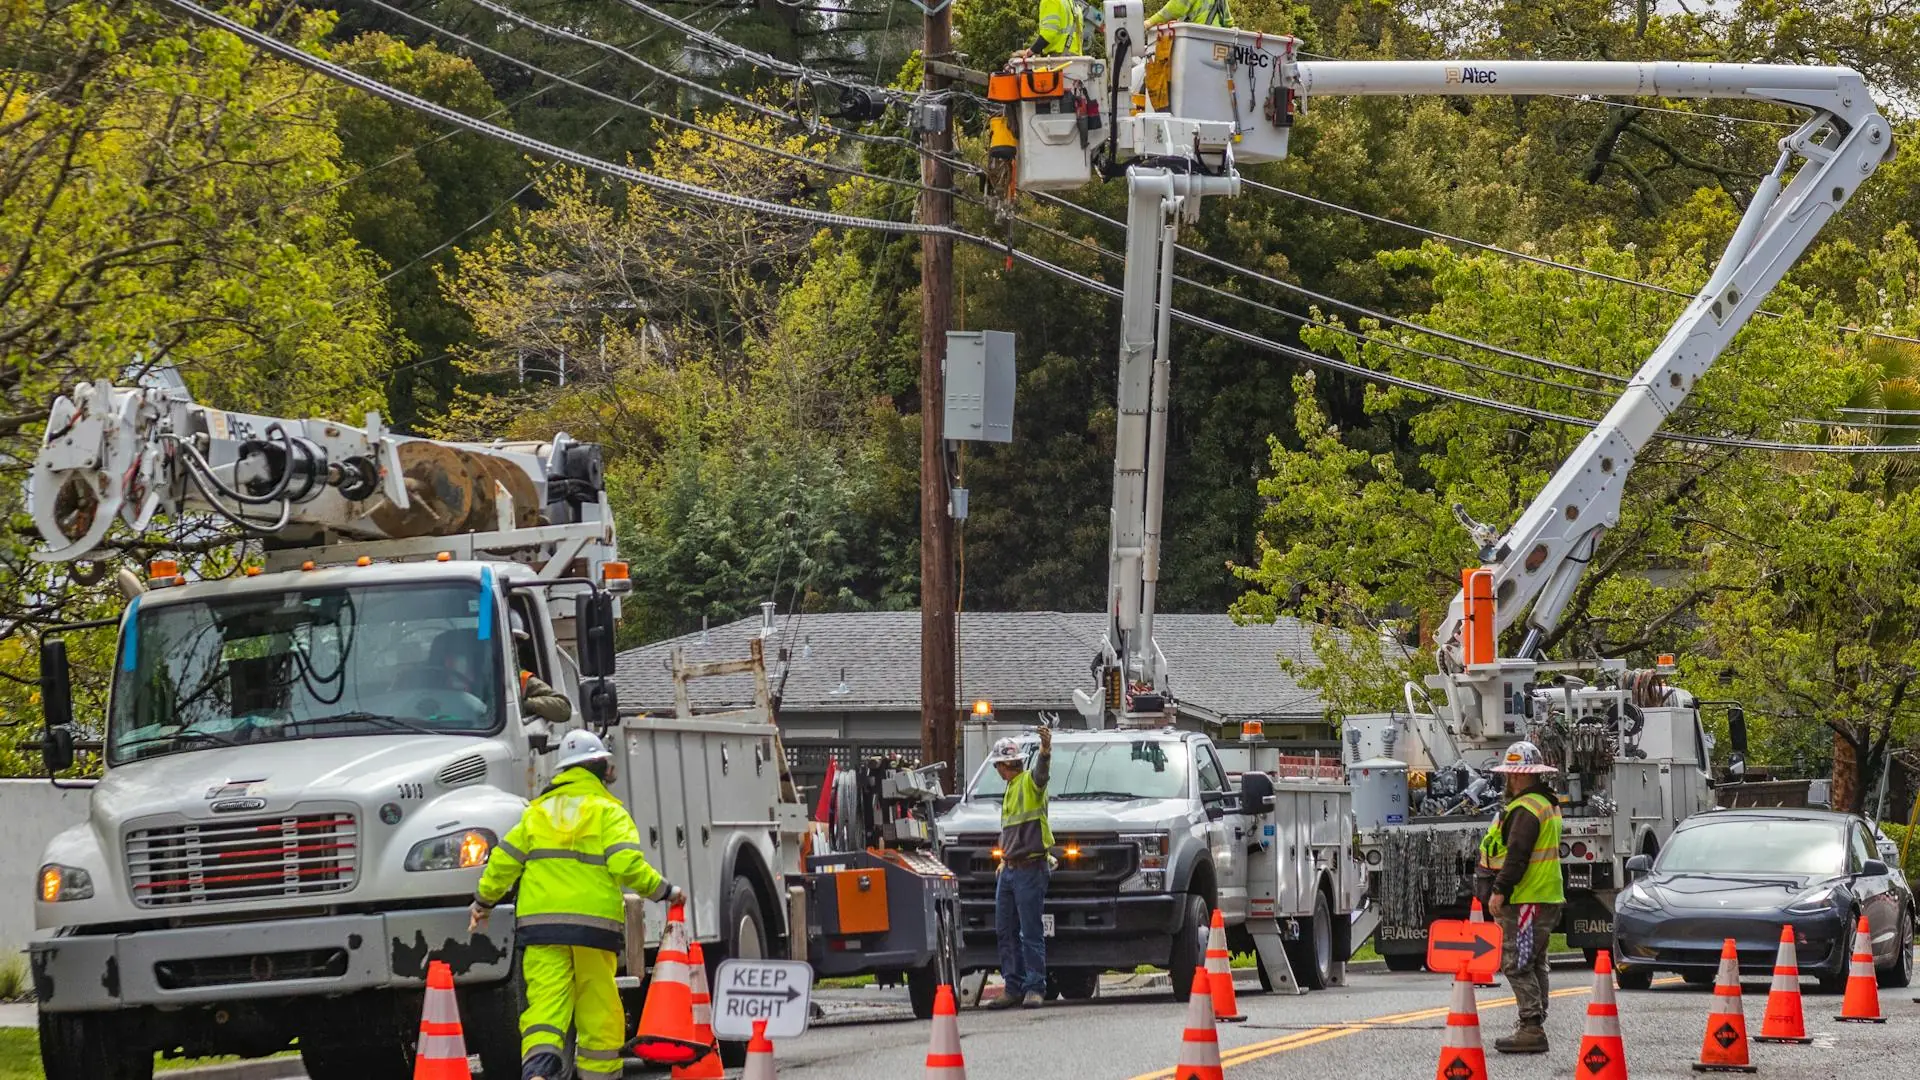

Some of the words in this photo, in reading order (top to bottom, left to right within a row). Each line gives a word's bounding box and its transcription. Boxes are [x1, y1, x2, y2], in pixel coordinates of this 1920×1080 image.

[1231, 46, 1268, 68] Altec
[1461, 67, 1497, 84] Altec
[1395, 926, 1428, 940] Altec
[1589, 919, 1614, 933] Alte
[733, 968, 787, 987] KEEP
[727, 998, 785, 1018] RIGHT
